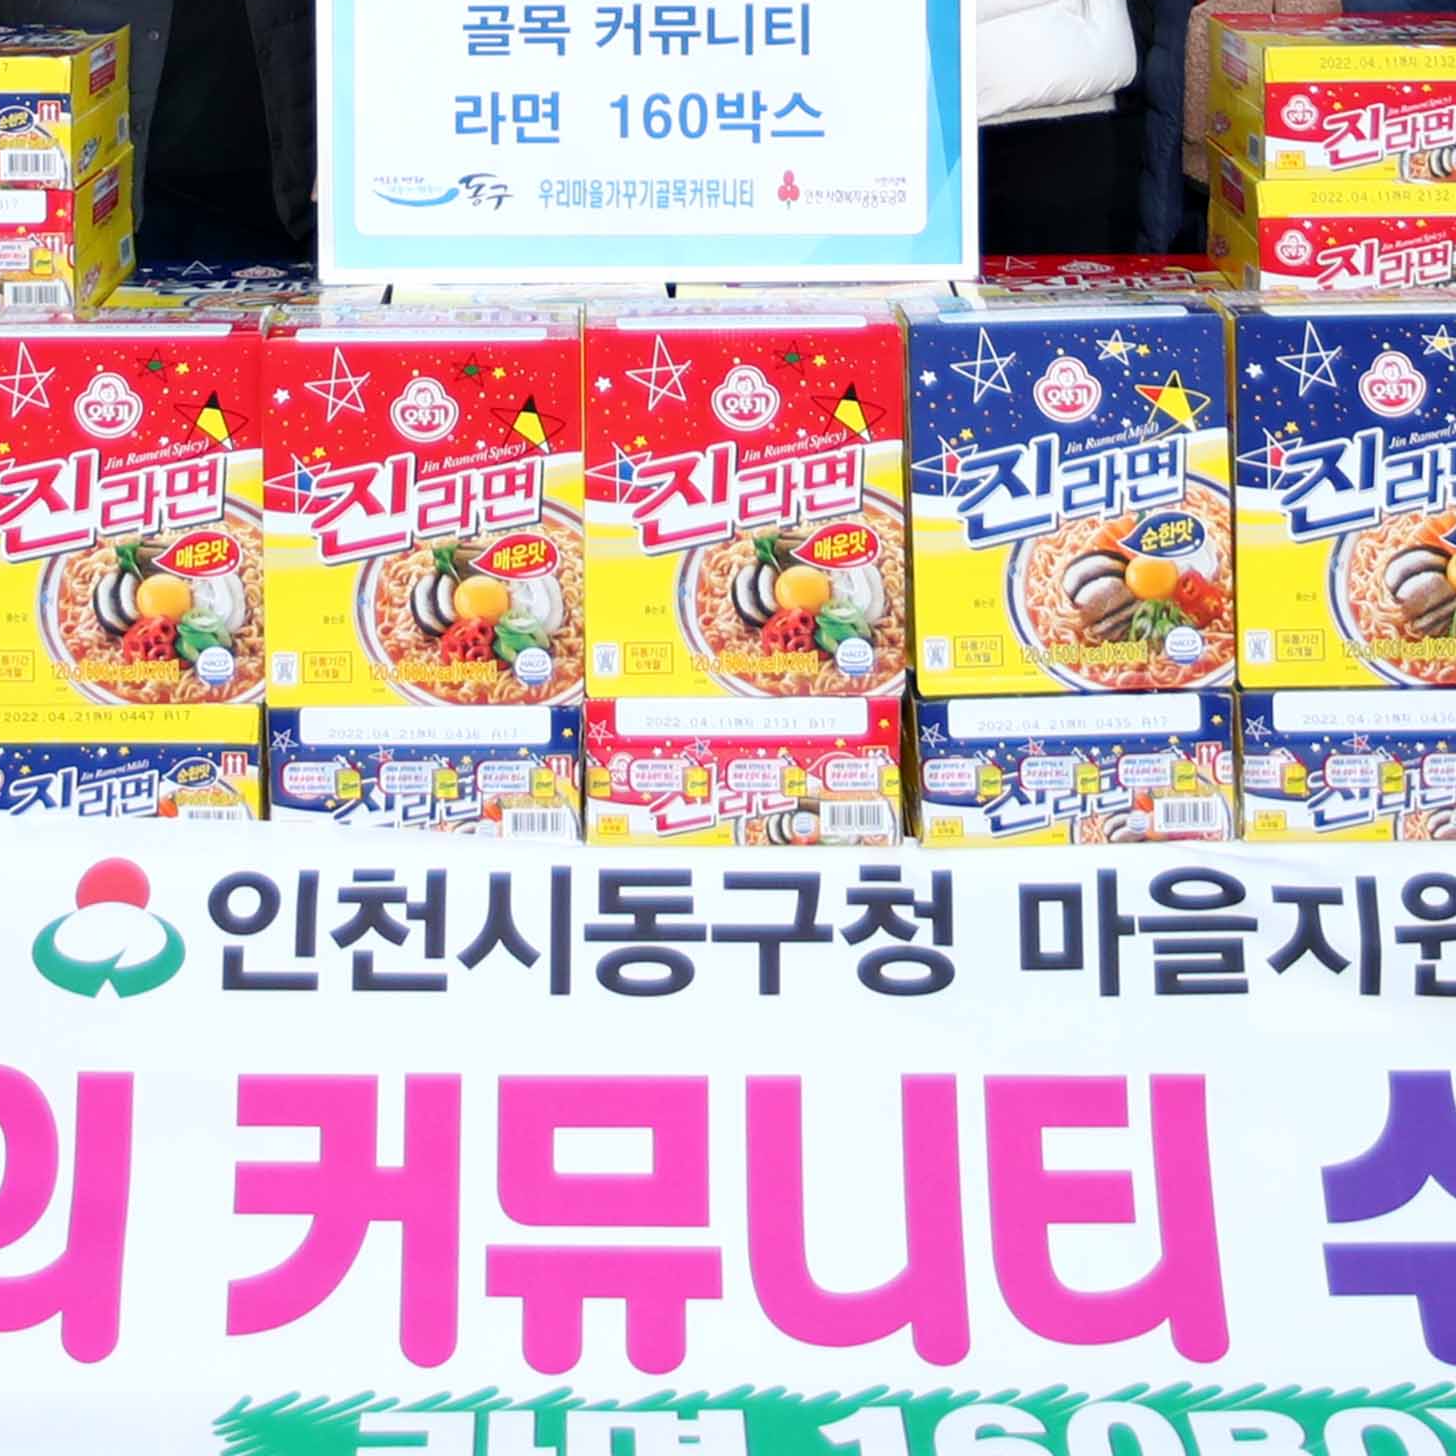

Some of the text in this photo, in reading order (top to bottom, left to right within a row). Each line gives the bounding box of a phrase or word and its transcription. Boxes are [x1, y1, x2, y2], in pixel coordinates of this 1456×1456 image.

[462, 3, 812, 57] 골목 커뮤니티
[454, 89, 827, 146] 라면 160박스
[538, 178, 755, 210] 우리마을가꾸기골목커뮤니티
[723, 397, 768, 414] 오뚜기
[1046, 389, 1088, 406] 오뚜기
[1371, 383, 1413, 400] 오뚜기
[86, 405, 130, 422] 오뚜기
[402, 409, 446, 426] 오뚜기
[741, 448, 761, 463] Jin
[1064, 438, 1082, 454] Jin
[1388, 432, 1407, 449] Jin
[104, 456, 123, 471] Jin
[420, 459, 440, 474] Jin
[633, 441, 862, 552] 진라면
[956, 433, 1187, 548] 진라면
[312, 452, 541, 563] 진라면
[813, 529, 869, 559] 매운맛
[1140, 518, 1195, 550] 순한맛
[175, 538, 230, 568] 매운맛
[492, 540, 547, 570] 매운맛
[208, 865, 956, 998] 인천시동구청
[226, 1071, 1231, 1376] 커뮤니티
